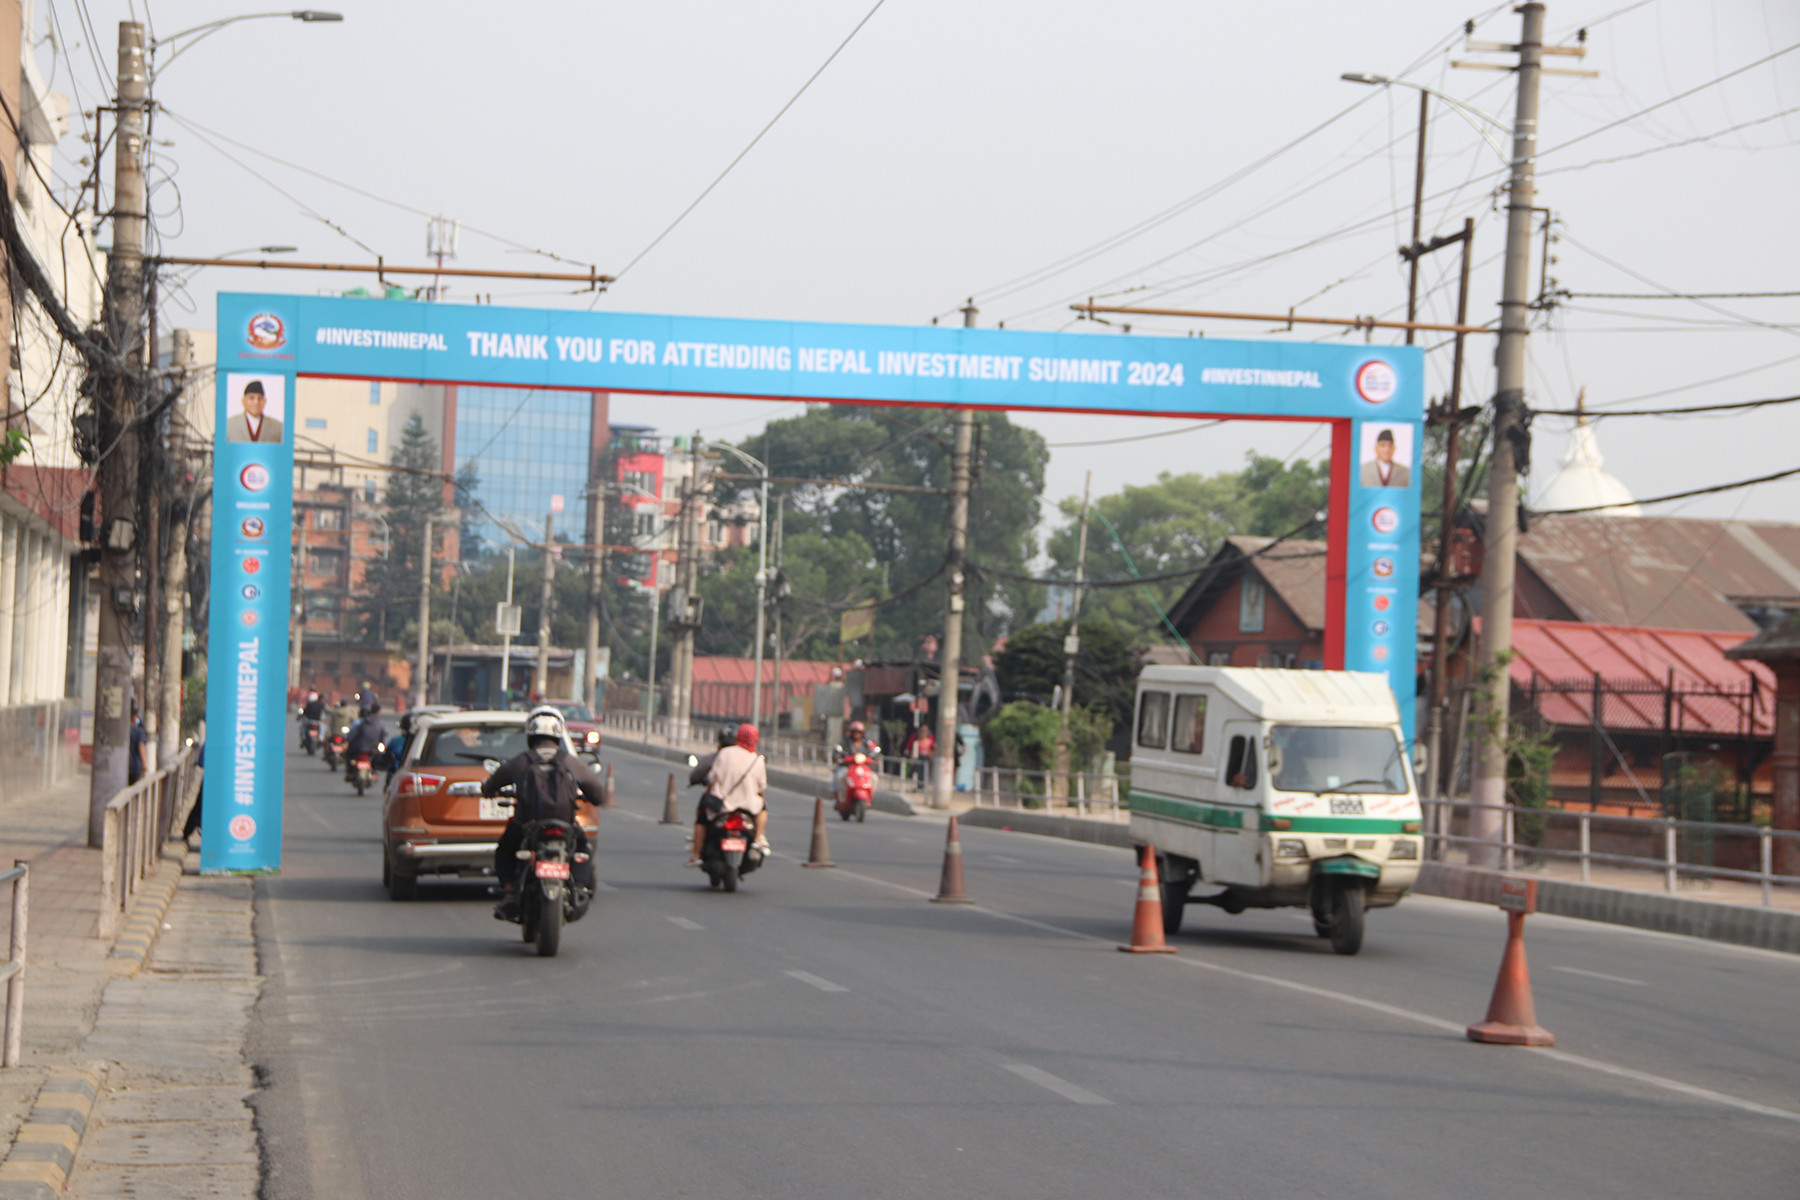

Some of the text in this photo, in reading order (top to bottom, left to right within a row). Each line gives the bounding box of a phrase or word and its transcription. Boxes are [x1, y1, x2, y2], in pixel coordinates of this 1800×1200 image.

[315, 327, 447, 352] #INVESTINNEPAL
[467, 331, 1185, 388] THANK YOU FOR ATTENDING NEPAL INVESTMENT SUMMIT 2024
[1201, 367, 1322, 389] #INVESTINNEPAL
[233, 636, 260, 806] #INVESTINNEPAL
